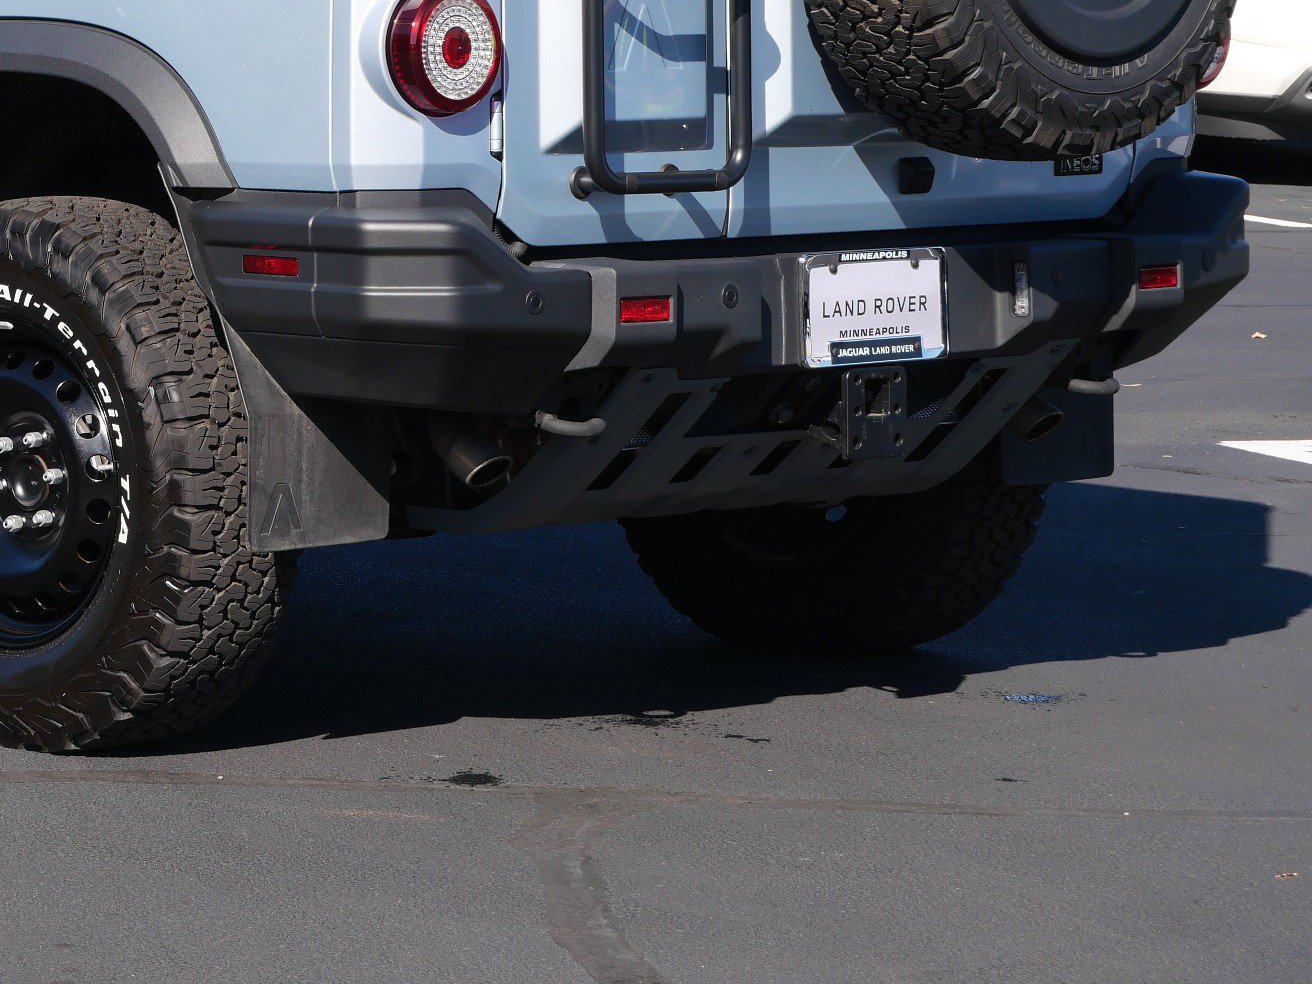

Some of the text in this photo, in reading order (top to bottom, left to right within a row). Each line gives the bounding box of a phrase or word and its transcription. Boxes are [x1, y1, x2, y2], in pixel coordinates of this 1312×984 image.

[1060, 154, 1100, 172] INEOS
[840, 250, 908, 261] MINNEAPOLIS
[822, 295, 928, 318] LAND ROVER
[839, 325, 910, 338] MINNEAPOLIS
[838, 344, 914, 357] JAGUAR LAND ROVER
[116, 472, 131, 546] T/A
